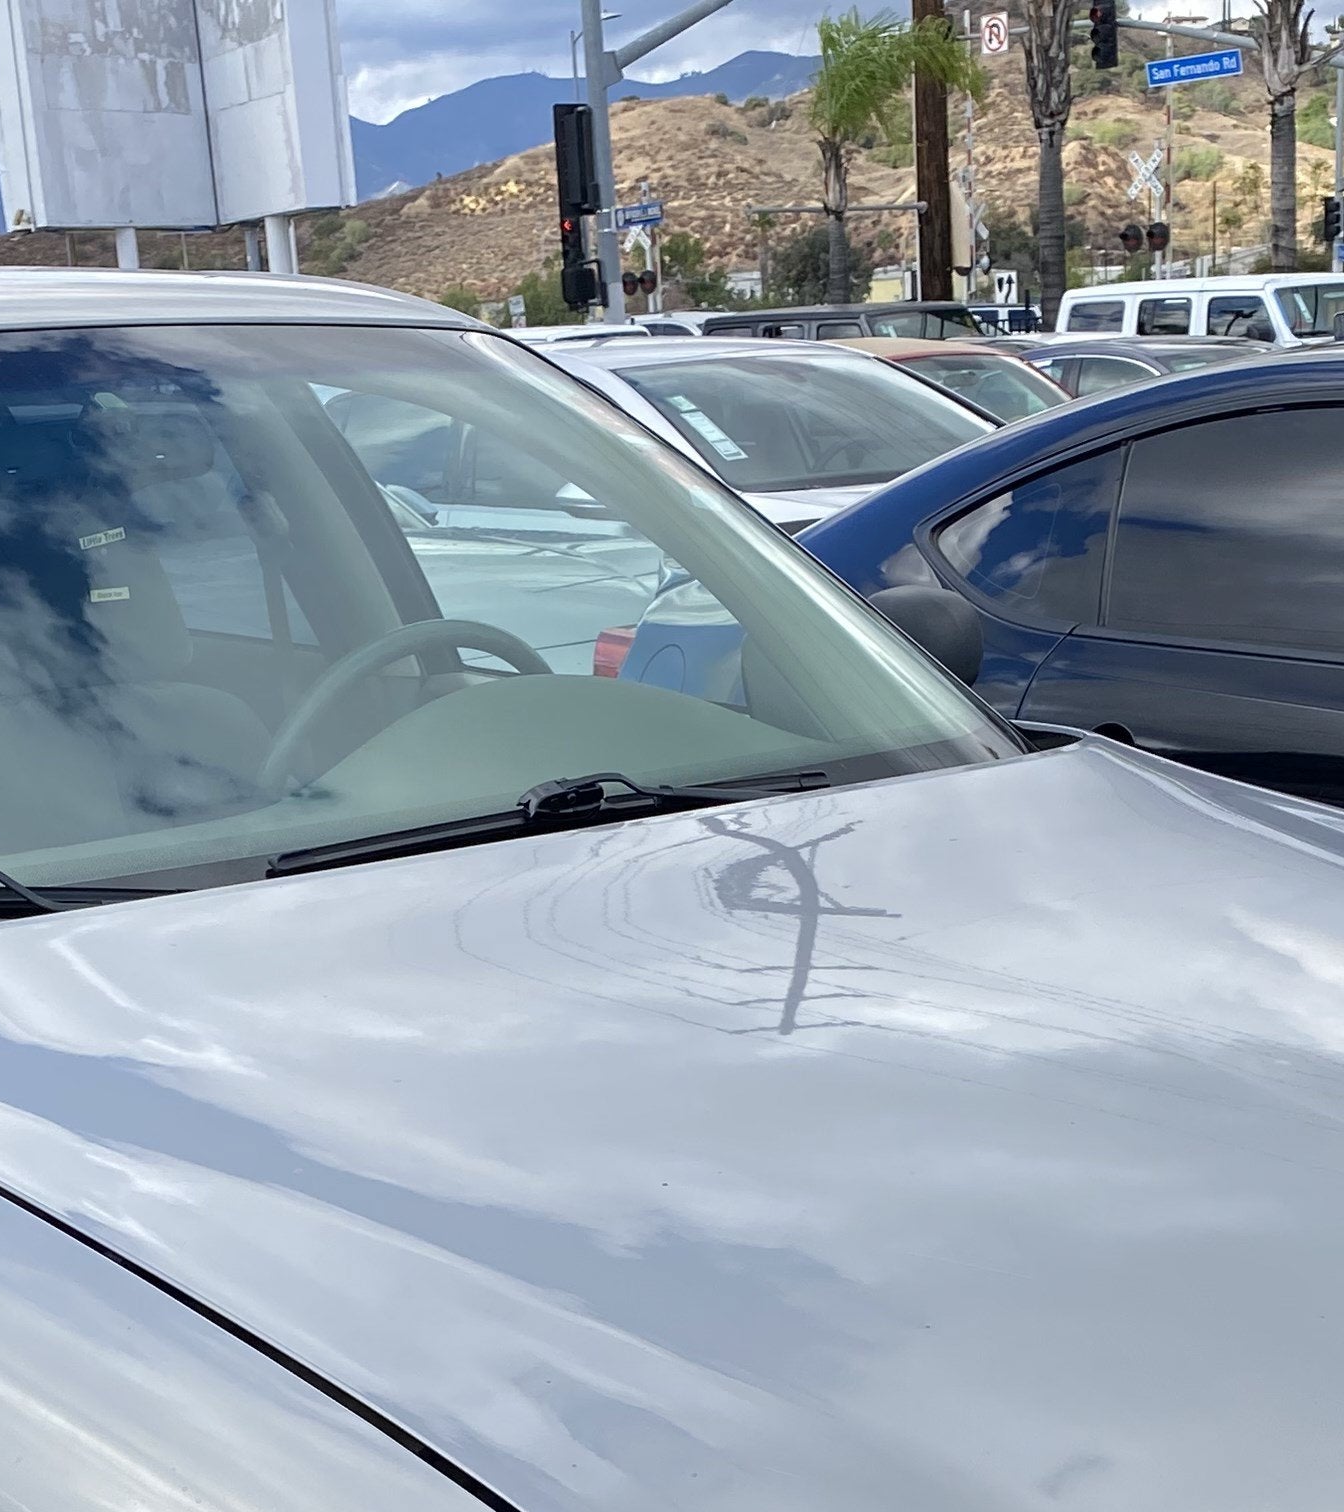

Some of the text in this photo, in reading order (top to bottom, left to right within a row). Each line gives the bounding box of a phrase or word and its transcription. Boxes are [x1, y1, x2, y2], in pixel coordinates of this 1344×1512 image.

[1151, 56, 1238, 80] San Fernando Rd
